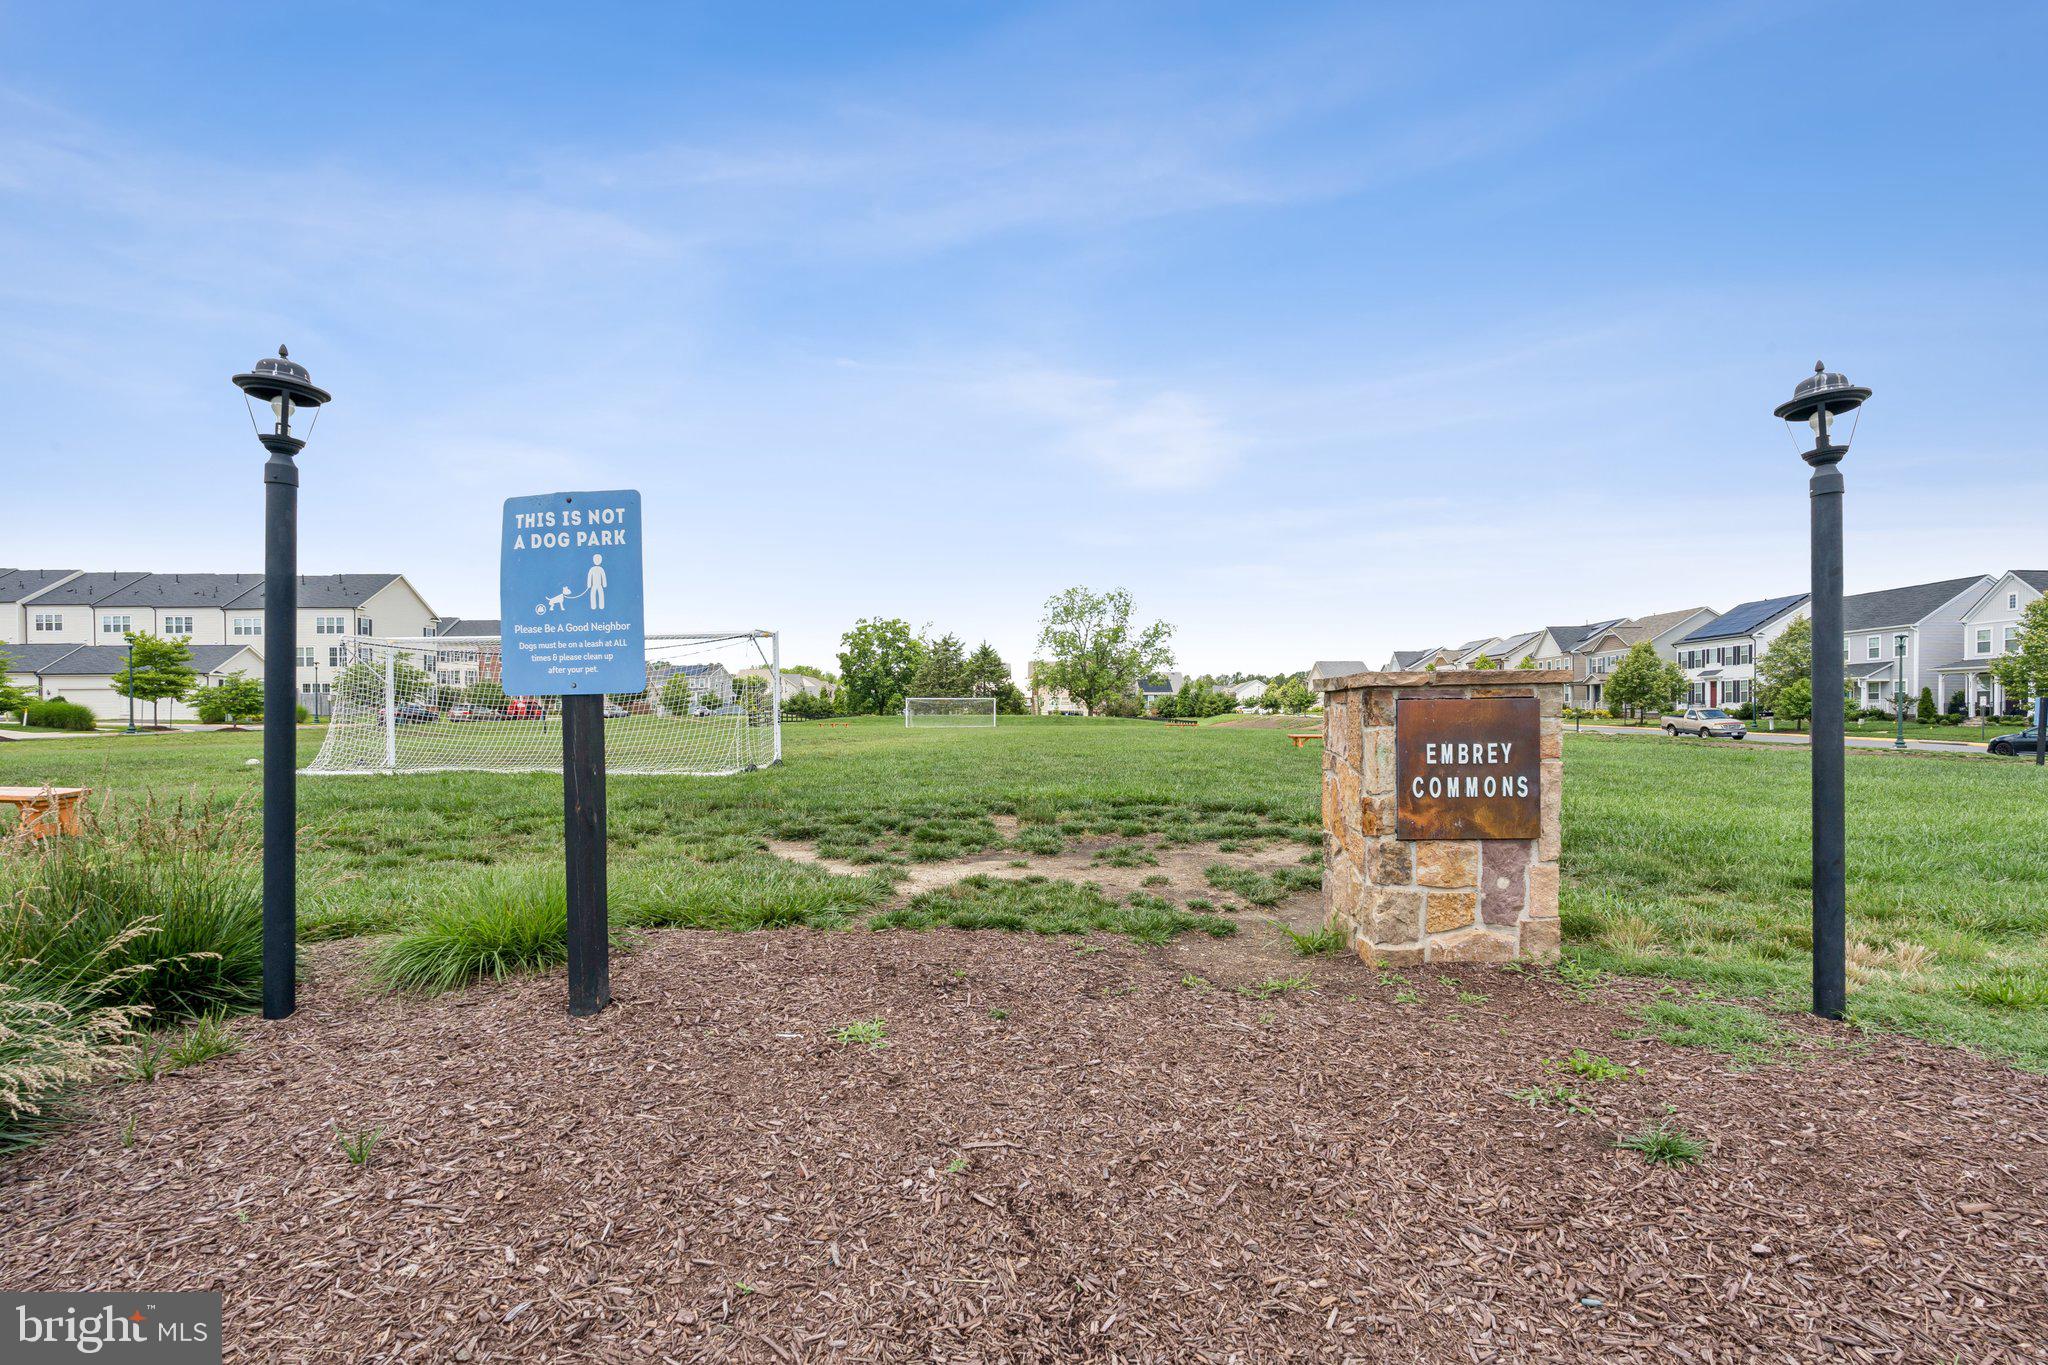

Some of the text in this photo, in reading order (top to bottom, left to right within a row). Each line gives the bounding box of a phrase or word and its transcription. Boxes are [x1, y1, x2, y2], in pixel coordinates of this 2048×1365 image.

[515, 508, 626, 528] THIS IS NOT
[514, 530, 626, 550] A DOG PARK
[514, 622, 630, 634] Please Be A Good Neighbor
[519, 642, 537, 652] Dogs
[558, 640, 567, 649] be
[584, 640, 604, 648] leash
[614, 639, 628, 647] ALL
[532, 652, 614, 664] times & please clean up
[548, 666, 598, 676] after your pet.
[1426, 742, 1512, 764] EMBREY
[1412, 776, 1529, 798] COMMONS
